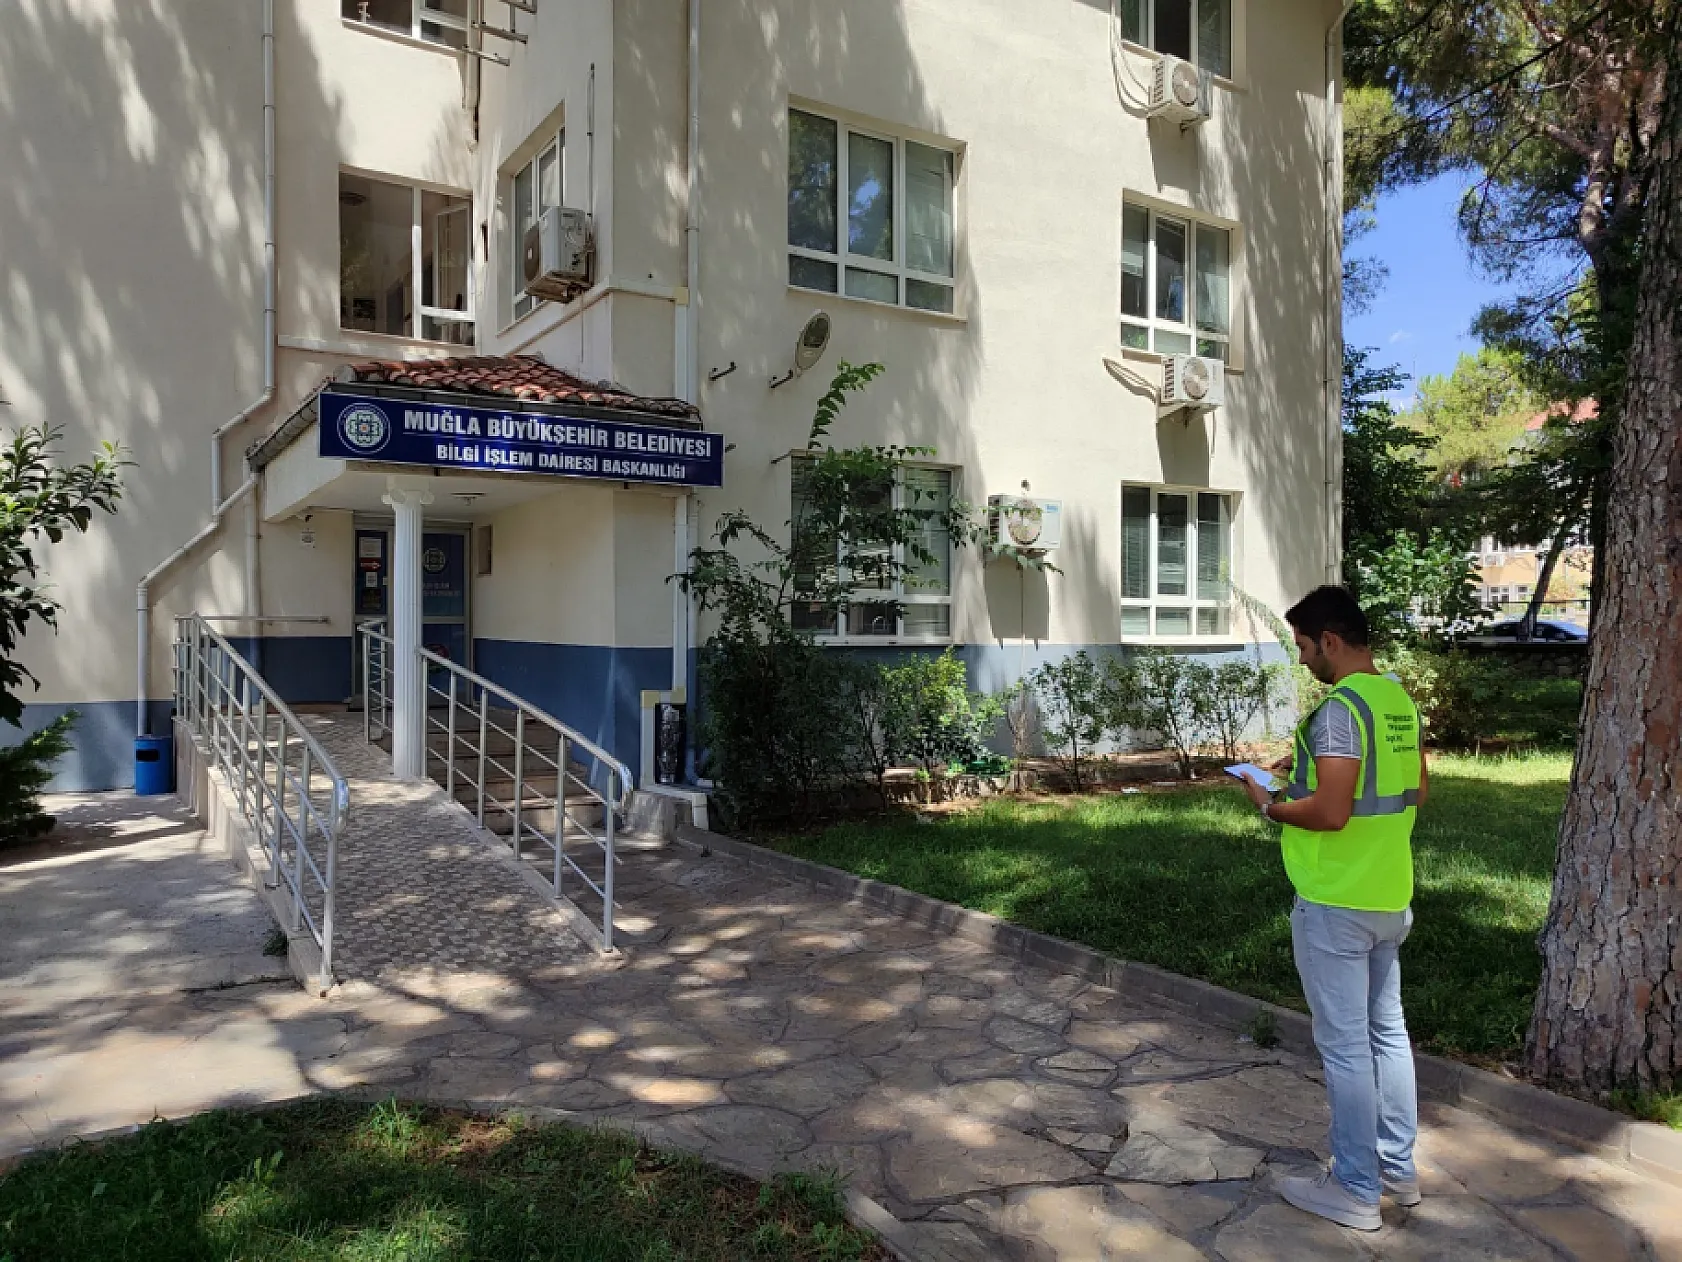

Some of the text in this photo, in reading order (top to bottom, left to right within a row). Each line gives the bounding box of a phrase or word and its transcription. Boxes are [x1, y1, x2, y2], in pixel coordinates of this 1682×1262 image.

[404, 409, 481, 435] MUĞLA
[487, 415, 608, 448] BÜYÜKŞEHİR
[614, 430, 711, 457] BELEDİYESİ
[436, 443, 686, 479] BİLGİ İŞLEM DAİRESİ BAŞKANLIĞI
